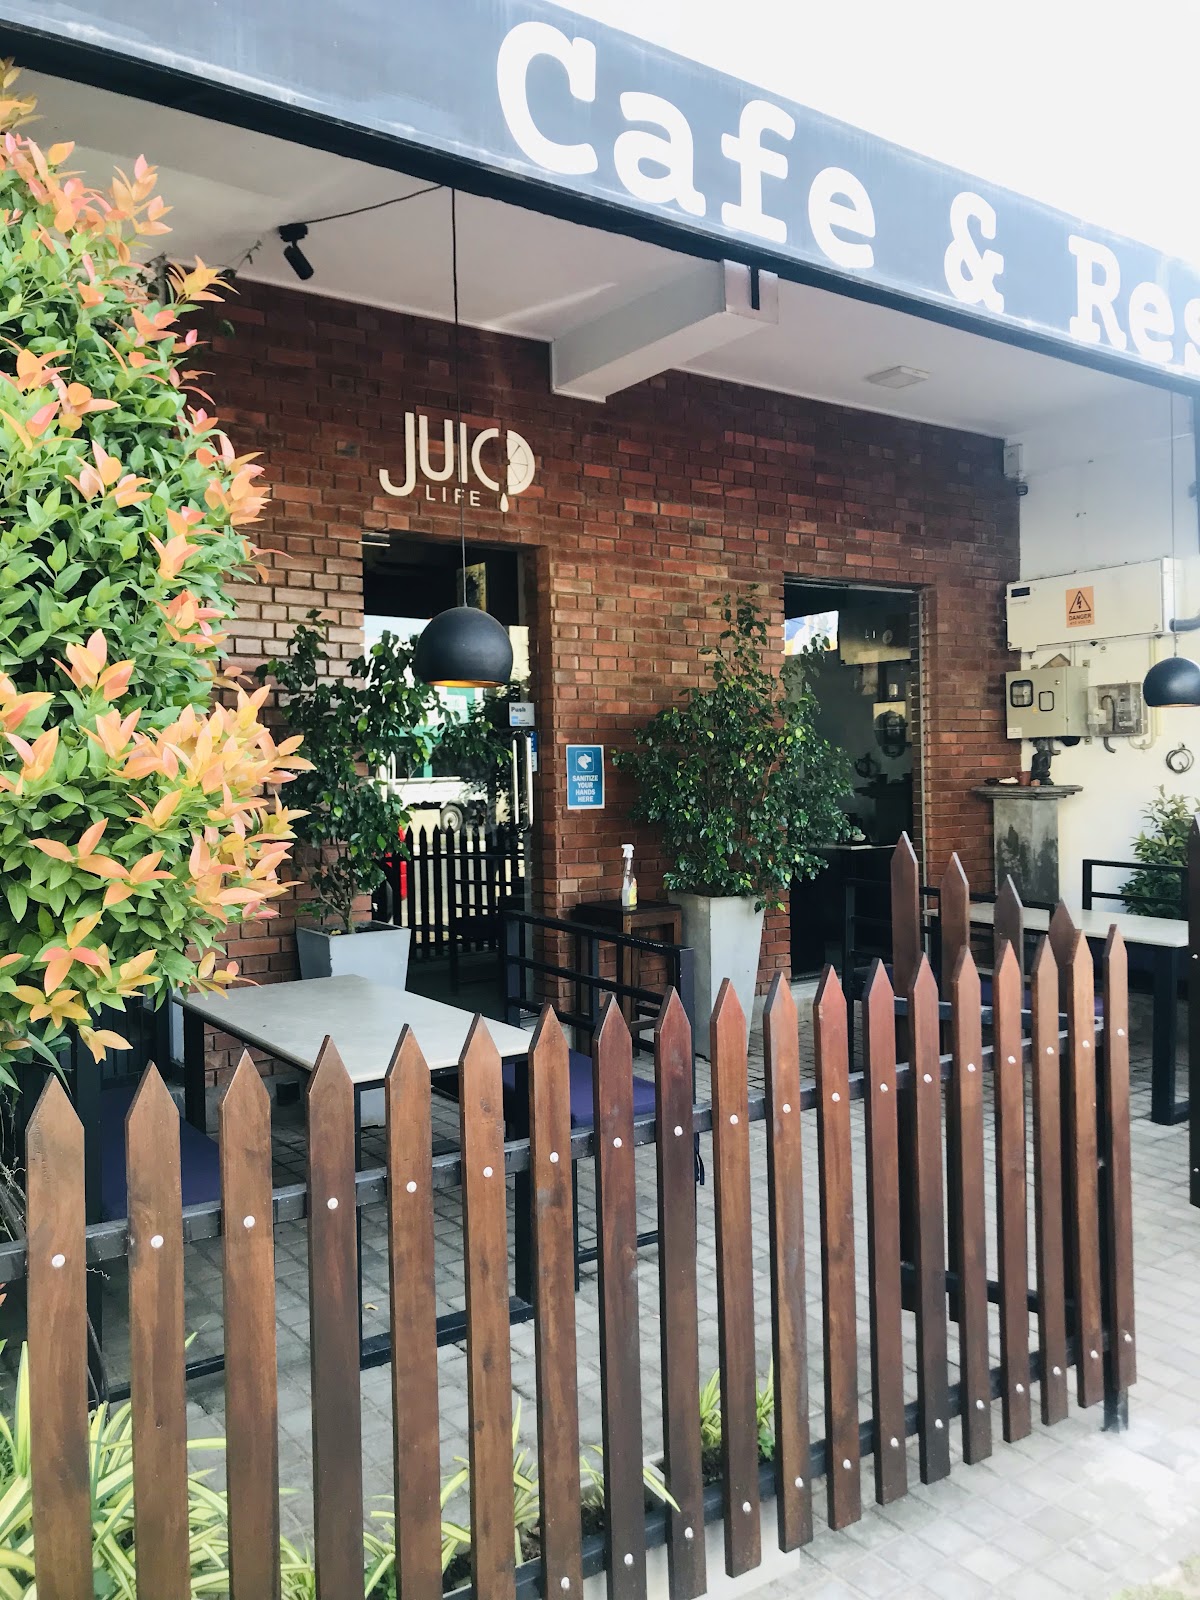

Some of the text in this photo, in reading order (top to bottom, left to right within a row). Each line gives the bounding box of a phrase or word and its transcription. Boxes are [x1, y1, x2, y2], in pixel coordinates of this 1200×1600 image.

[497, 21, 876, 269] Cafe
[944, 192, 1005, 314] &
[425, 484, 481, 507] LIFE
[1068, 613, 1092, 621] DANGER
[572, 774, 599, 782] SANITIZE
[575, 788, 596, 796] HANDS
[577, 795, 594, 803] HERE
